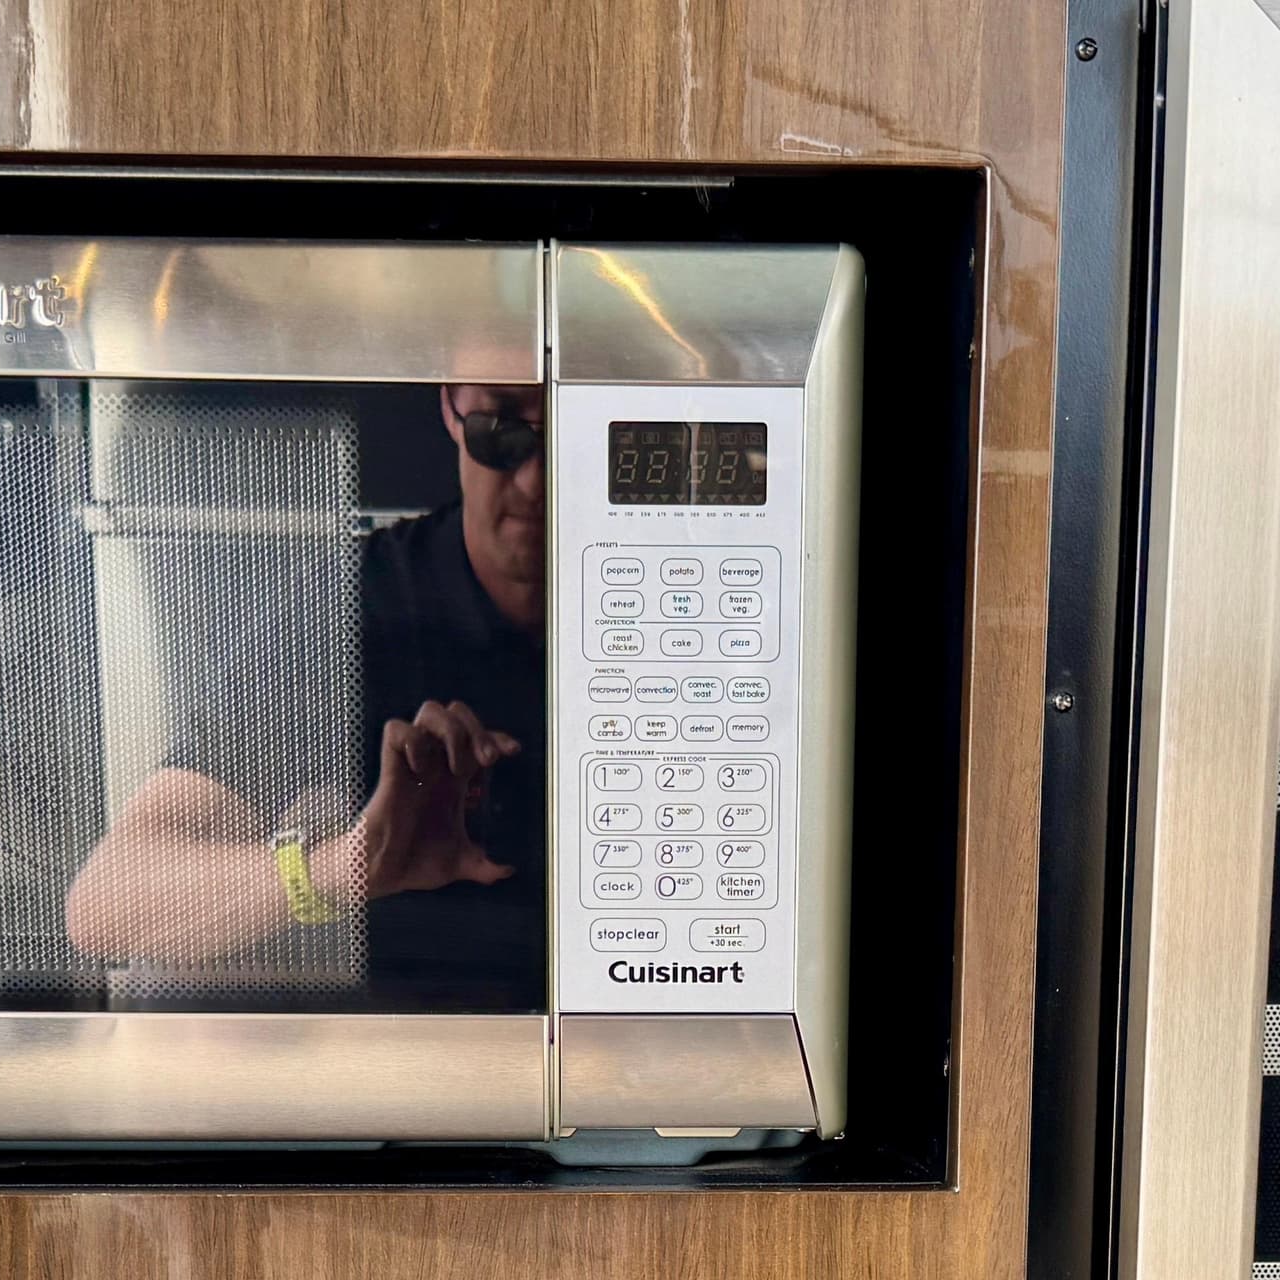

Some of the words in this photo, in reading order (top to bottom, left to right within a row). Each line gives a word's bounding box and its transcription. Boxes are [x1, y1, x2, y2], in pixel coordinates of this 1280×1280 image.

[606, 567, 640, 576] popcorn
[669, 567, 695, 577] potato
[721, 567, 760, 578] beverage
[672, 594, 692, 604] fresh
[609, 600, 636, 609] reheat
[673, 605, 692, 615] veg.
[732, 605, 751, 615] veg.
[607, 645, 639, 653] chicken
[671, 640, 693, 648] cake
[730, 639, 751, 649] pizza
[590, 686, 631, 695] microwave
[636, 686, 677, 695] convection
[693, 690, 713, 699] roast
[746, 690, 766, 700] bake
[647, 719, 667, 730] keep
[690, 724, 716, 734] defrost
[732, 723, 765, 733] memory
[601, 767, 607, 788] 1
[662, 767, 676, 788] 2
[721, 767, 736, 788] 3
[599, 807, 612, 827] 4
[661, 807, 675, 828] 5
[722, 807, 735, 828] 6
[598, 844, 611, 865] 7
[660, 844, 674, 865] 8
[722, 844, 734, 865] 9
[600, 881, 635, 892] clock
[720, 877, 761, 887] kitchen
[727, 887, 755, 897] timer
[714, 924, 741, 935] start
[597, 928, 660, 943] stopclear
[608, 961, 743, 983] Cuisinart
